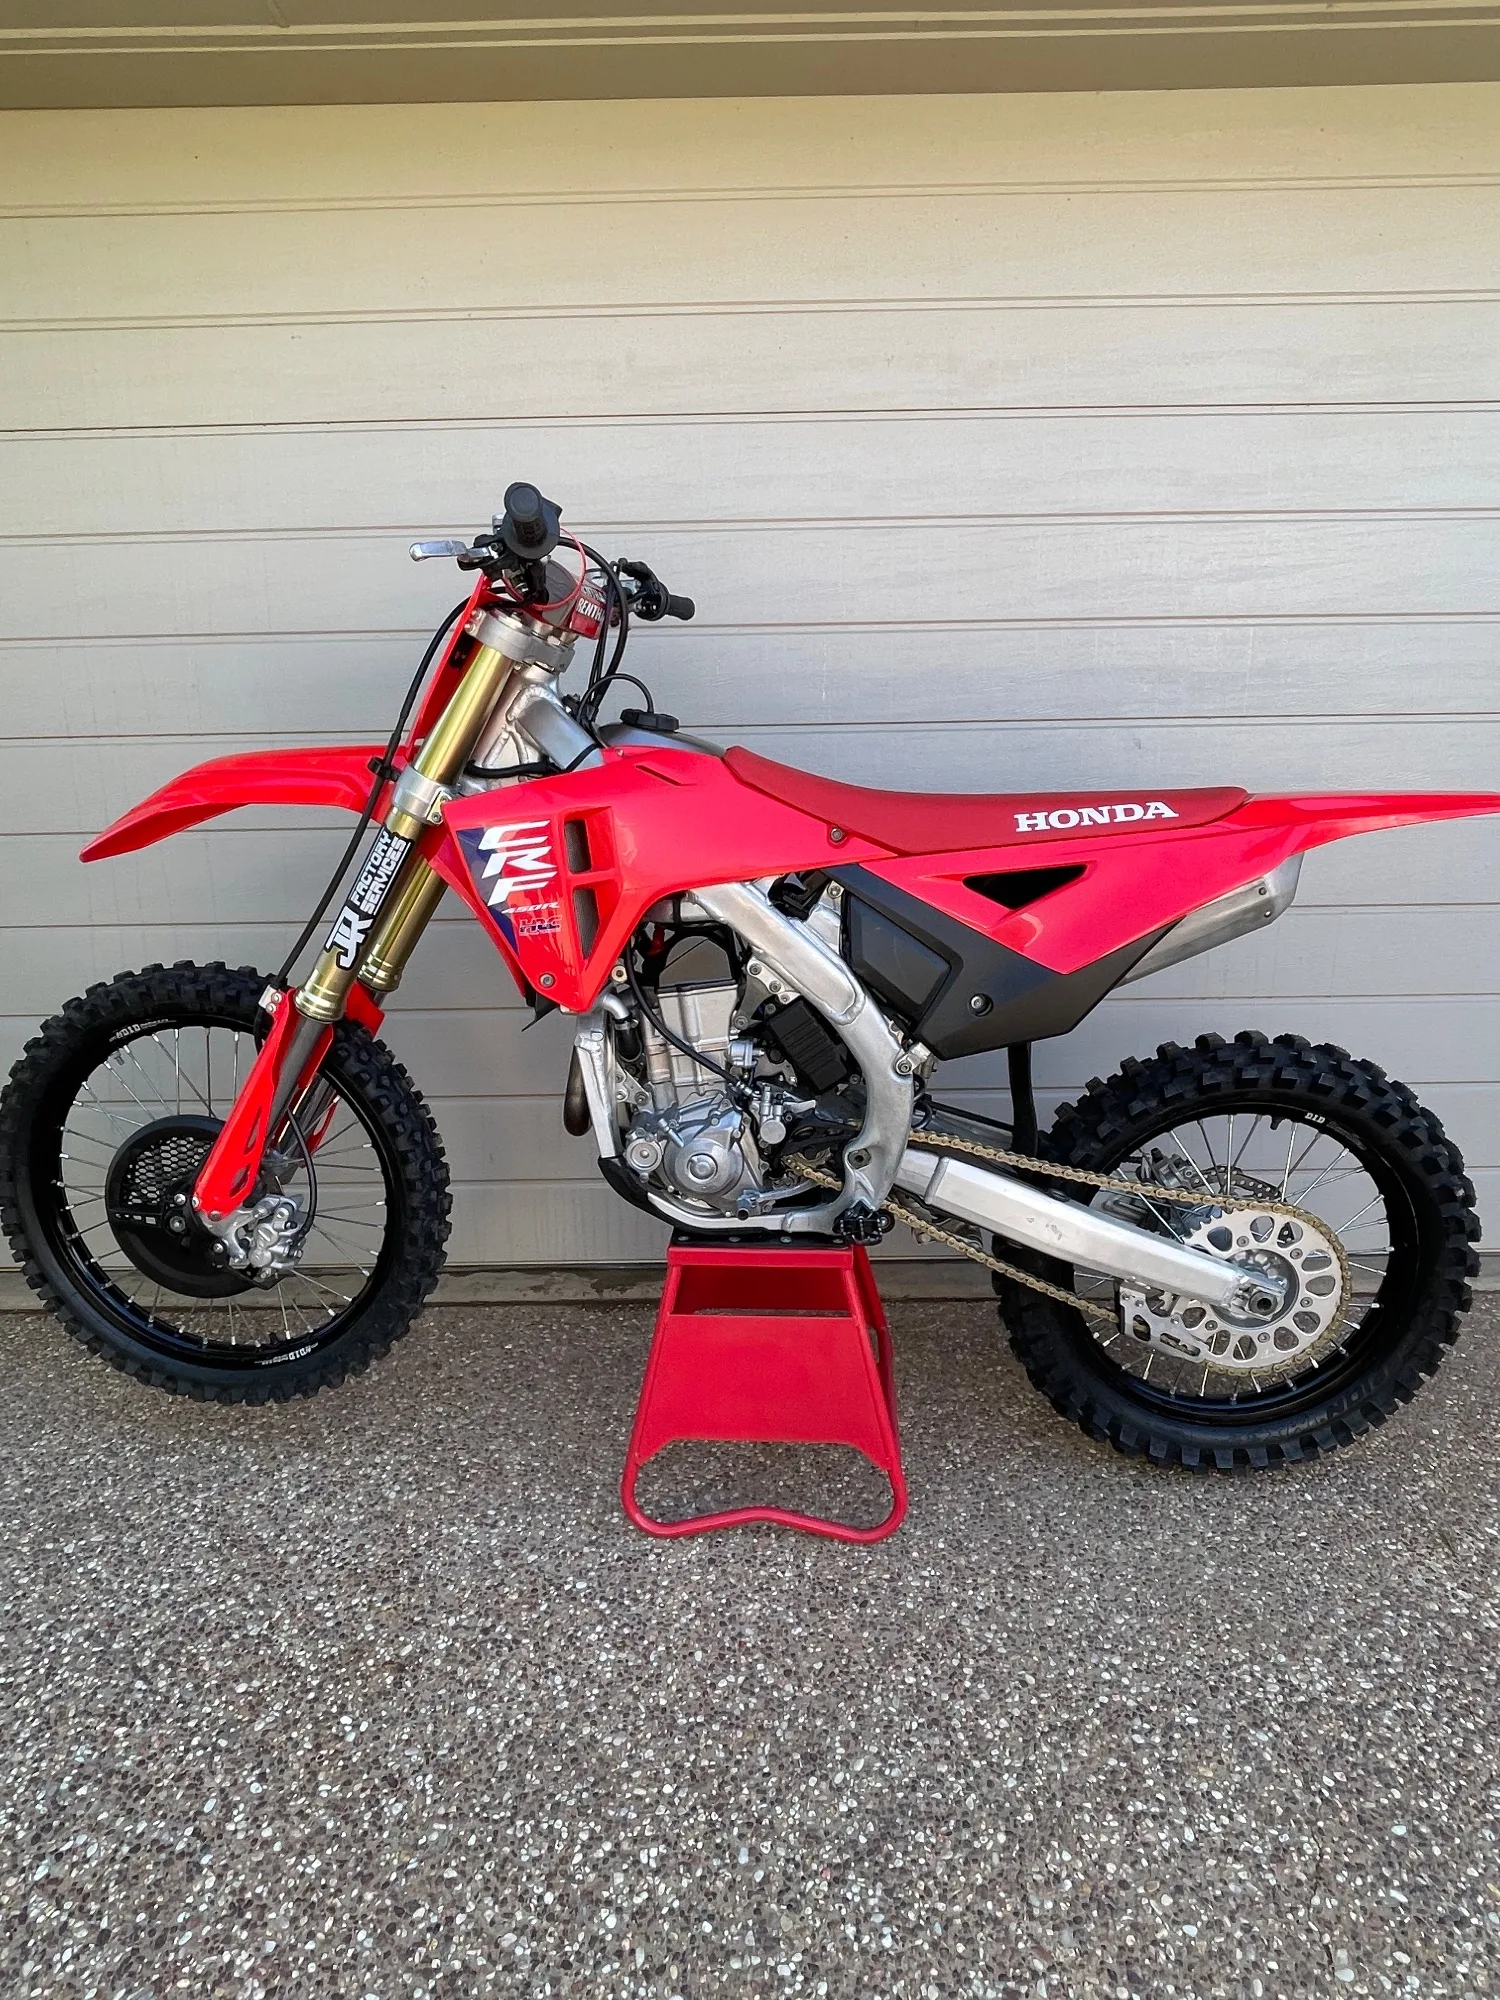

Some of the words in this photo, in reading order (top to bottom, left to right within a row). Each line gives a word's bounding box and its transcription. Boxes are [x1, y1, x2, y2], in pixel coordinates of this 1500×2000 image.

[577, 597, 606, 621] RENTH
[1013, 801, 1180, 833] HONDA
[350, 830, 392, 906] FACTORY
[360, 836, 407, 915] SERVICES
[477, 819, 559, 907] CRF
